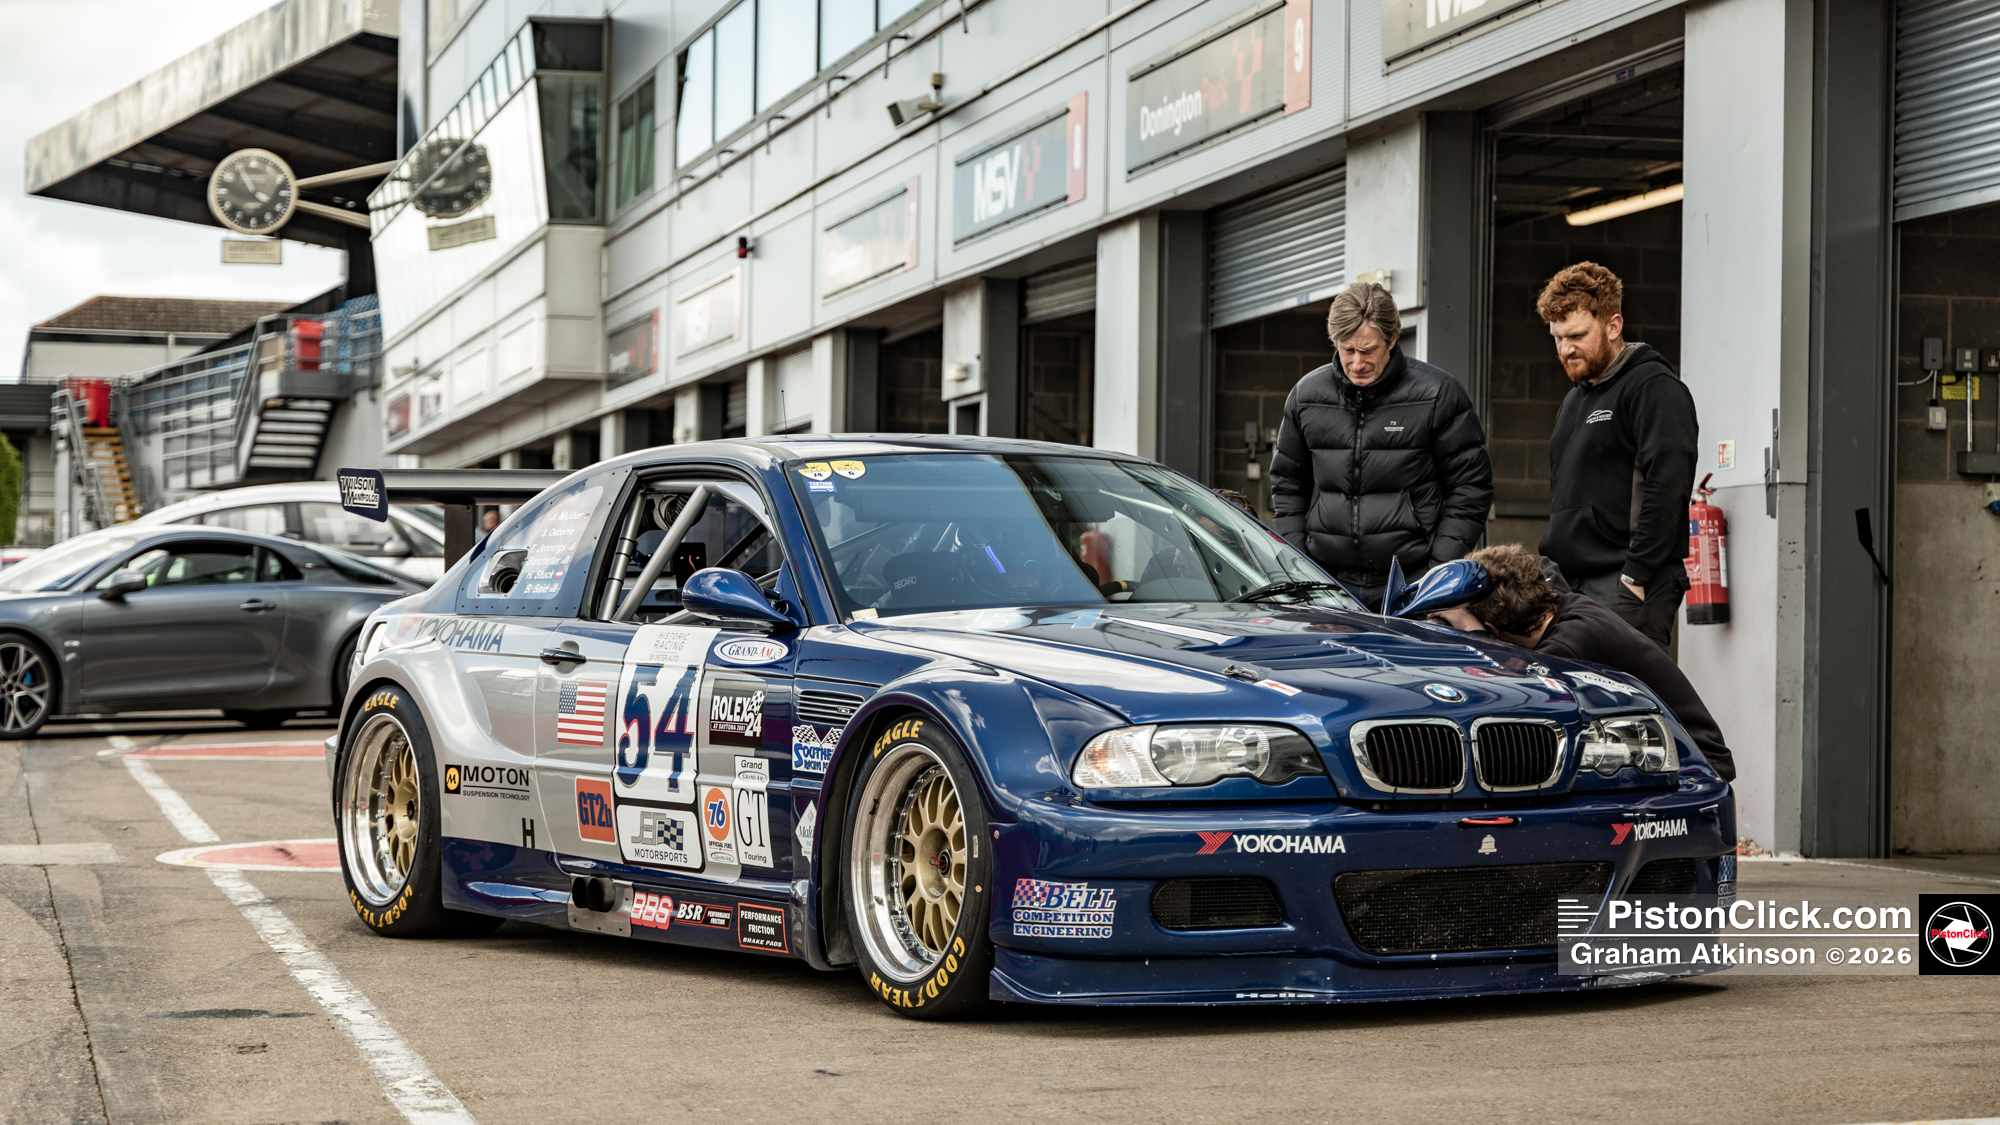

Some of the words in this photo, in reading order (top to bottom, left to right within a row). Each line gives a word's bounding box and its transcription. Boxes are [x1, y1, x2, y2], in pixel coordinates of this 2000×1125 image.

[1294, 17, 1304, 73] 9
[973, 144, 1022, 224] MSV
[340, 476, 376, 492] WILSON
[534, 569, 555, 579] Stuck
[894, 575, 918, 590] RECARO
[966, 609, 1112, 632] 54
[414, 619, 507, 652] YOKOHAMA
[653, 640, 685, 651] RACING
[658, 632, 690, 640] HISTORIC
[364, 691, 400, 712] EAGLE
[711, 695, 751, 722] ROLEX
[617, 662, 700, 794] 54
[744, 711, 762, 737] 24
[873, 720, 923, 758] EAGLE
[741, 759, 763, 769] Grand
[794, 743, 833, 768] SOUTHE
[804, 760, 821, 771] RACING
[463, 765, 529, 786] MOTON
[463, 790, 499, 798] SUSPENSION
[499, 792, 530, 801] TECHNOLOGY
[578, 791, 613, 829] GT2b
[708, 799, 726, 828] 76
[737, 787, 765, 847] GT
[522, 817, 536, 849] H
[631, 811, 666, 846] JET
[1634, 818, 1688, 841] YOKOHAMA
[709, 840, 723, 848] OFFICIAL
[1232, 835, 1346, 853] YOKOHAMA
[634, 848, 688, 863] MOTORSPORTS
[744, 851, 767, 863] Touring
[1041, 884, 1116, 910] BELL
[630, 892, 672, 924] BBS
[676, 903, 704, 921] BSR
[740, 910, 782, 924] PERFORMANCE
[1014, 911, 1113, 922] COMPETITION
[748, 924, 775, 936] FRICTION
[1014, 925, 1111, 936] ENGINEERING
[742, 937, 764, 945] BRAKE
[765, 939, 782, 948] PADS
